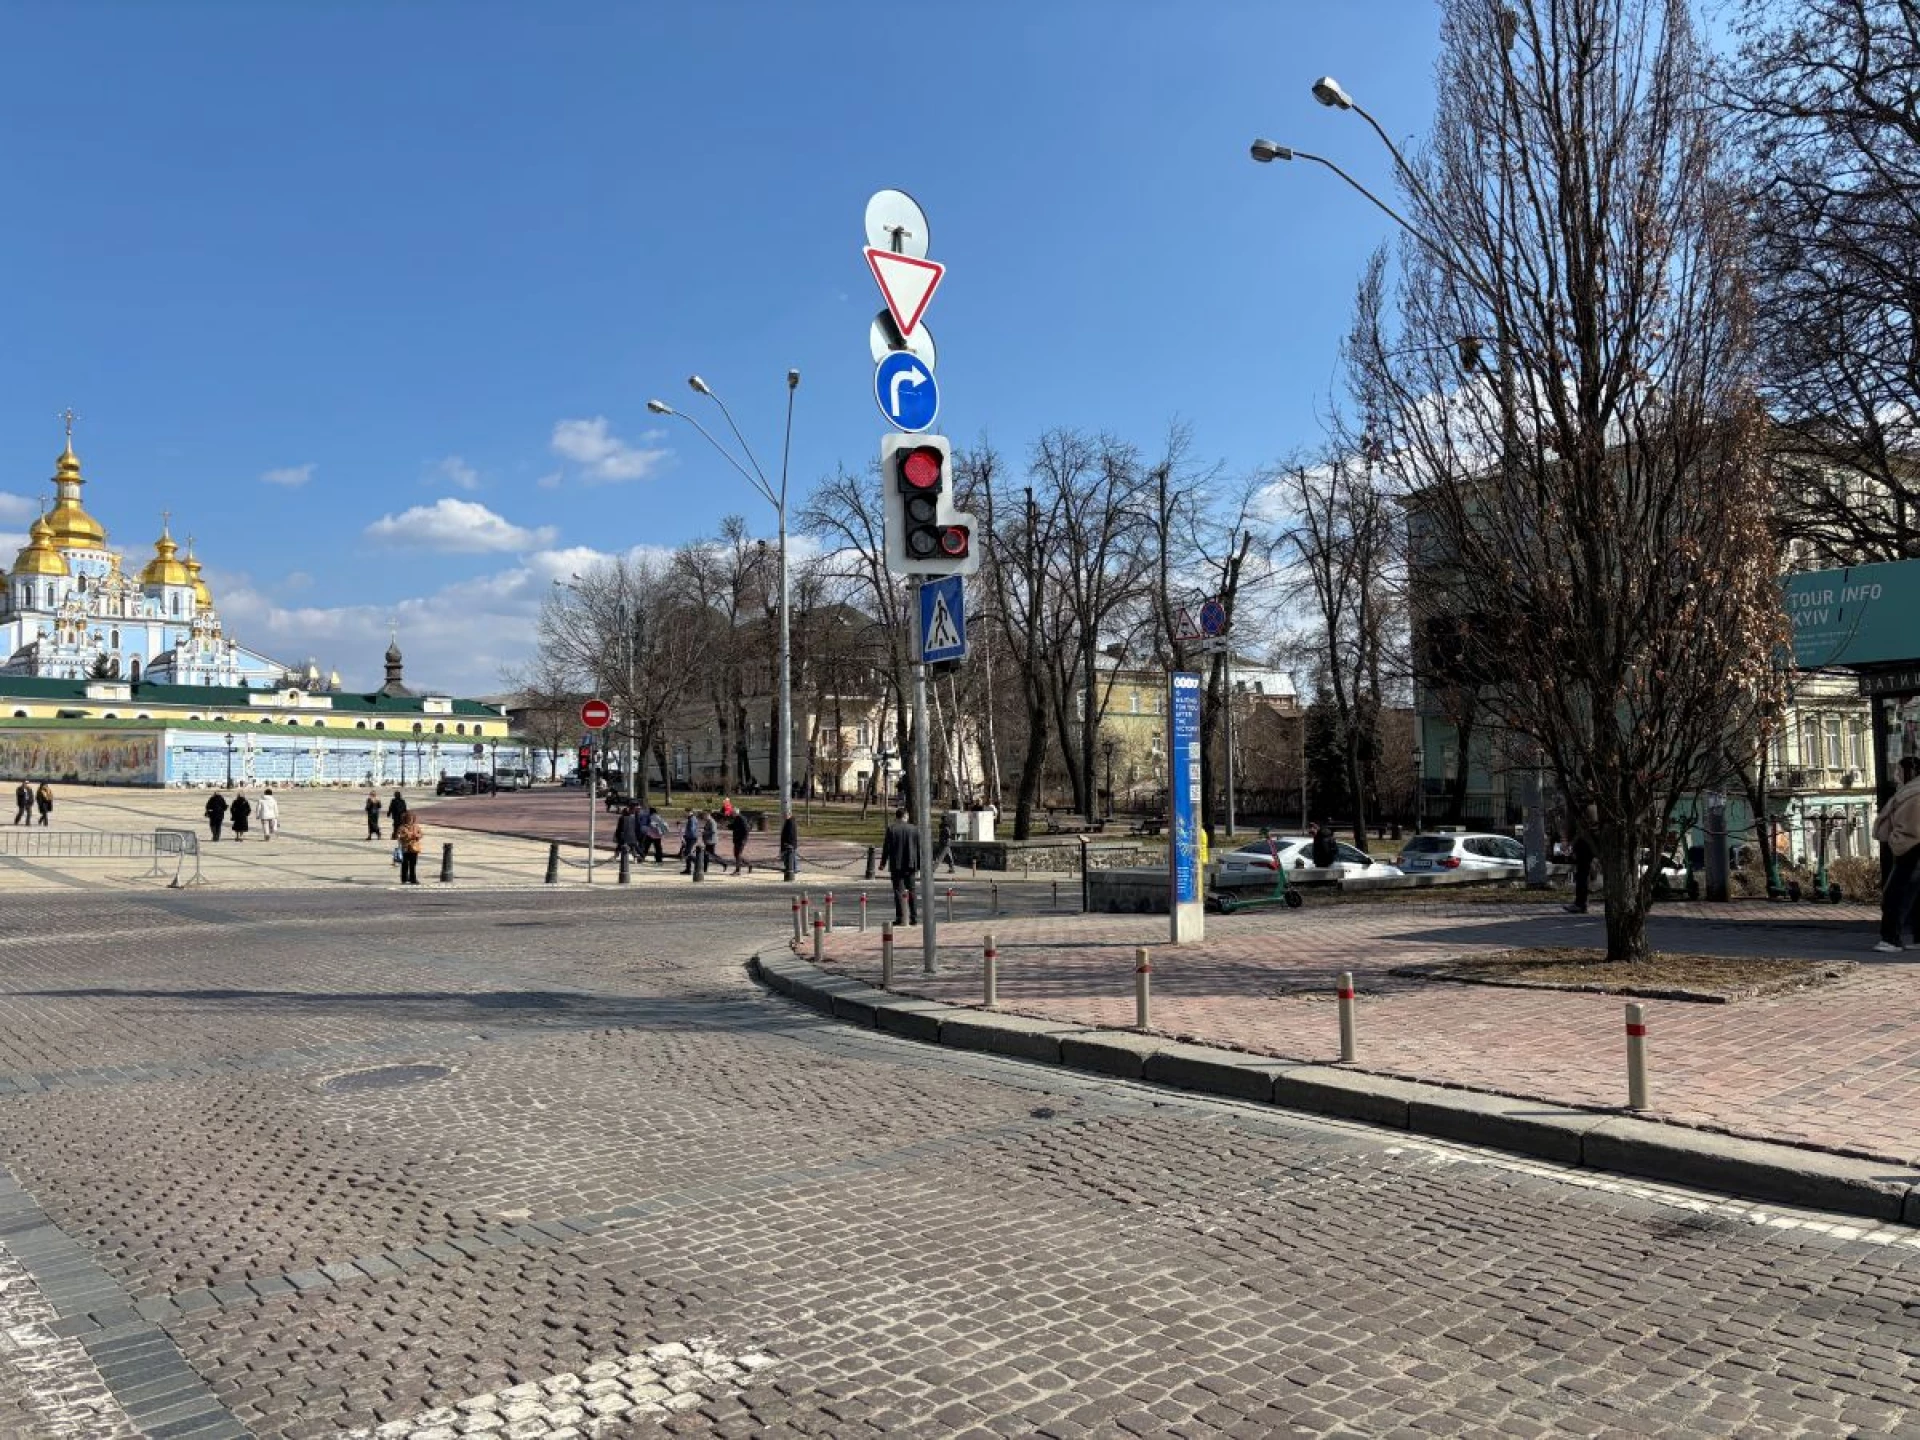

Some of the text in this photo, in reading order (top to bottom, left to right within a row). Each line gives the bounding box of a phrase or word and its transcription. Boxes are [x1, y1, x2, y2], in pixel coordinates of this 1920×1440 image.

[1791, 584, 1883, 608] TOUR INFO
[1791, 608, 1829, 627] KYIV
